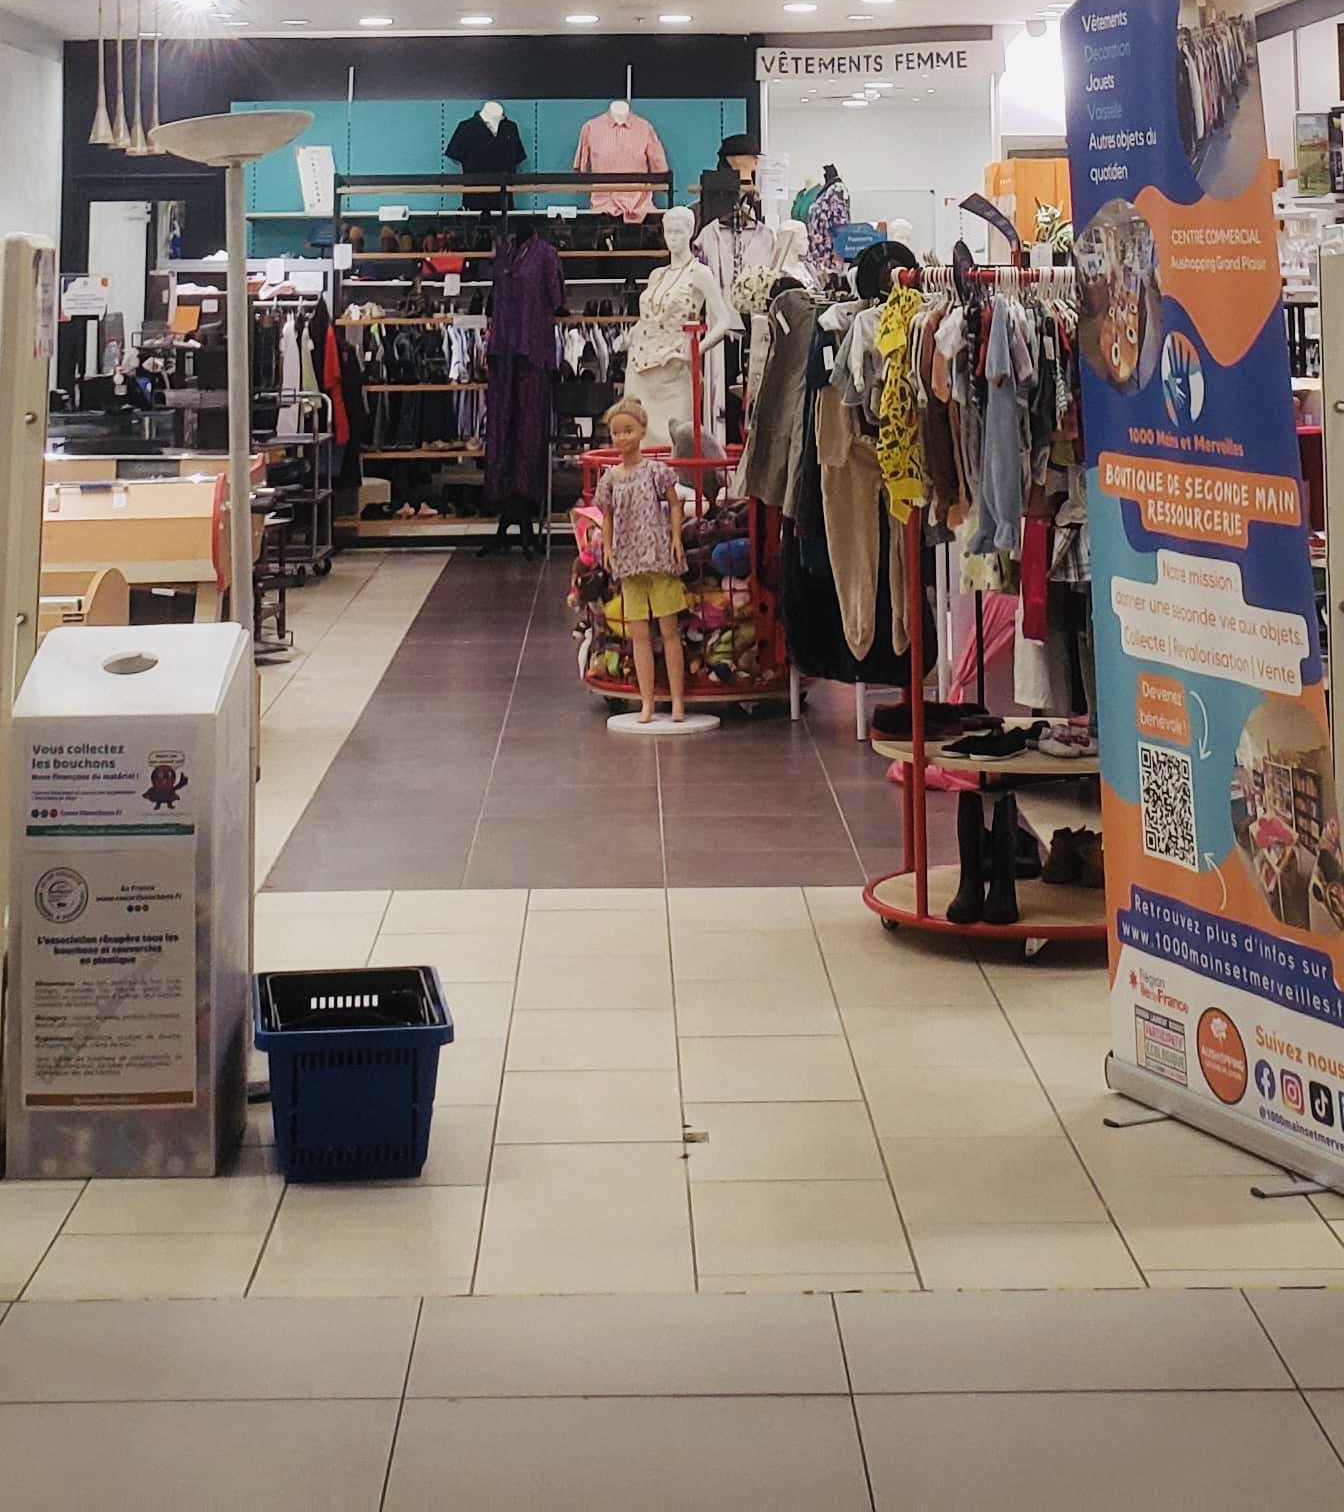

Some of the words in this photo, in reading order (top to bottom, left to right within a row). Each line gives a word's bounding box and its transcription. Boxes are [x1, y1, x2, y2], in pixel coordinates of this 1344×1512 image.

[1082, 10, 1128, 33] Vêtements
[761, 51, 883, 75] VÊTEMENTS
[895, 50, 968, 71] FEMME
[1086, 73, 1115, 92] Jouets
[1089, 131, 1115, 150] Autres
[1116, 129, 1145, 152] objets
[1146, 127, 1157, 145] du
[1171, 228, 1205, 245] CENTRE
[1206, 228, 1262, 245] COMMERCIAL
[1128, 427, 1154, 446] 1000
[1181, 433, 1192, 450] et
[1106, 463, 1164, 492] BOUTIQUE
[1167, 473, 1180, 496] DE
[1184, 476, 1249, 506] SECONDE
[1256, 486, 1295, 516] MAIN
[1147, 499, 1243, 537] RESSOURCERIE
[1162, 559, 1186, 584] Notre
[1189, 571, 1233, 592] mission
[1150, 600, 1170, 616] une
[1172, 604, 1216, 627] seconde
[1220, 614, 1237, 630] vie
[1239, 619, 1256, 634] aux
[1260, 621, 1304, 648] objets.
[1124, 626, 1166, 652] Collecte
[1173, 640, 1249, 674] Revalorisation
[1257, 658, 1296, 685] Vente
[1142, 680, 1184, 707] Devenez
[32, 744, 64, 755] Vous
[67, 743, 124, 755] collectez
[32, 758, 50, 769] les
[53, 757, 116, 769] bouchons
[1134, 893, 1200, 935] Retrouvez
[1206, 923, 1238, 948] plus
[1244, 935, 1295, 970] d'infos
[1302, 959, 1328, 980] sur
[1256, 1025, 1303, 1064] Suivez
